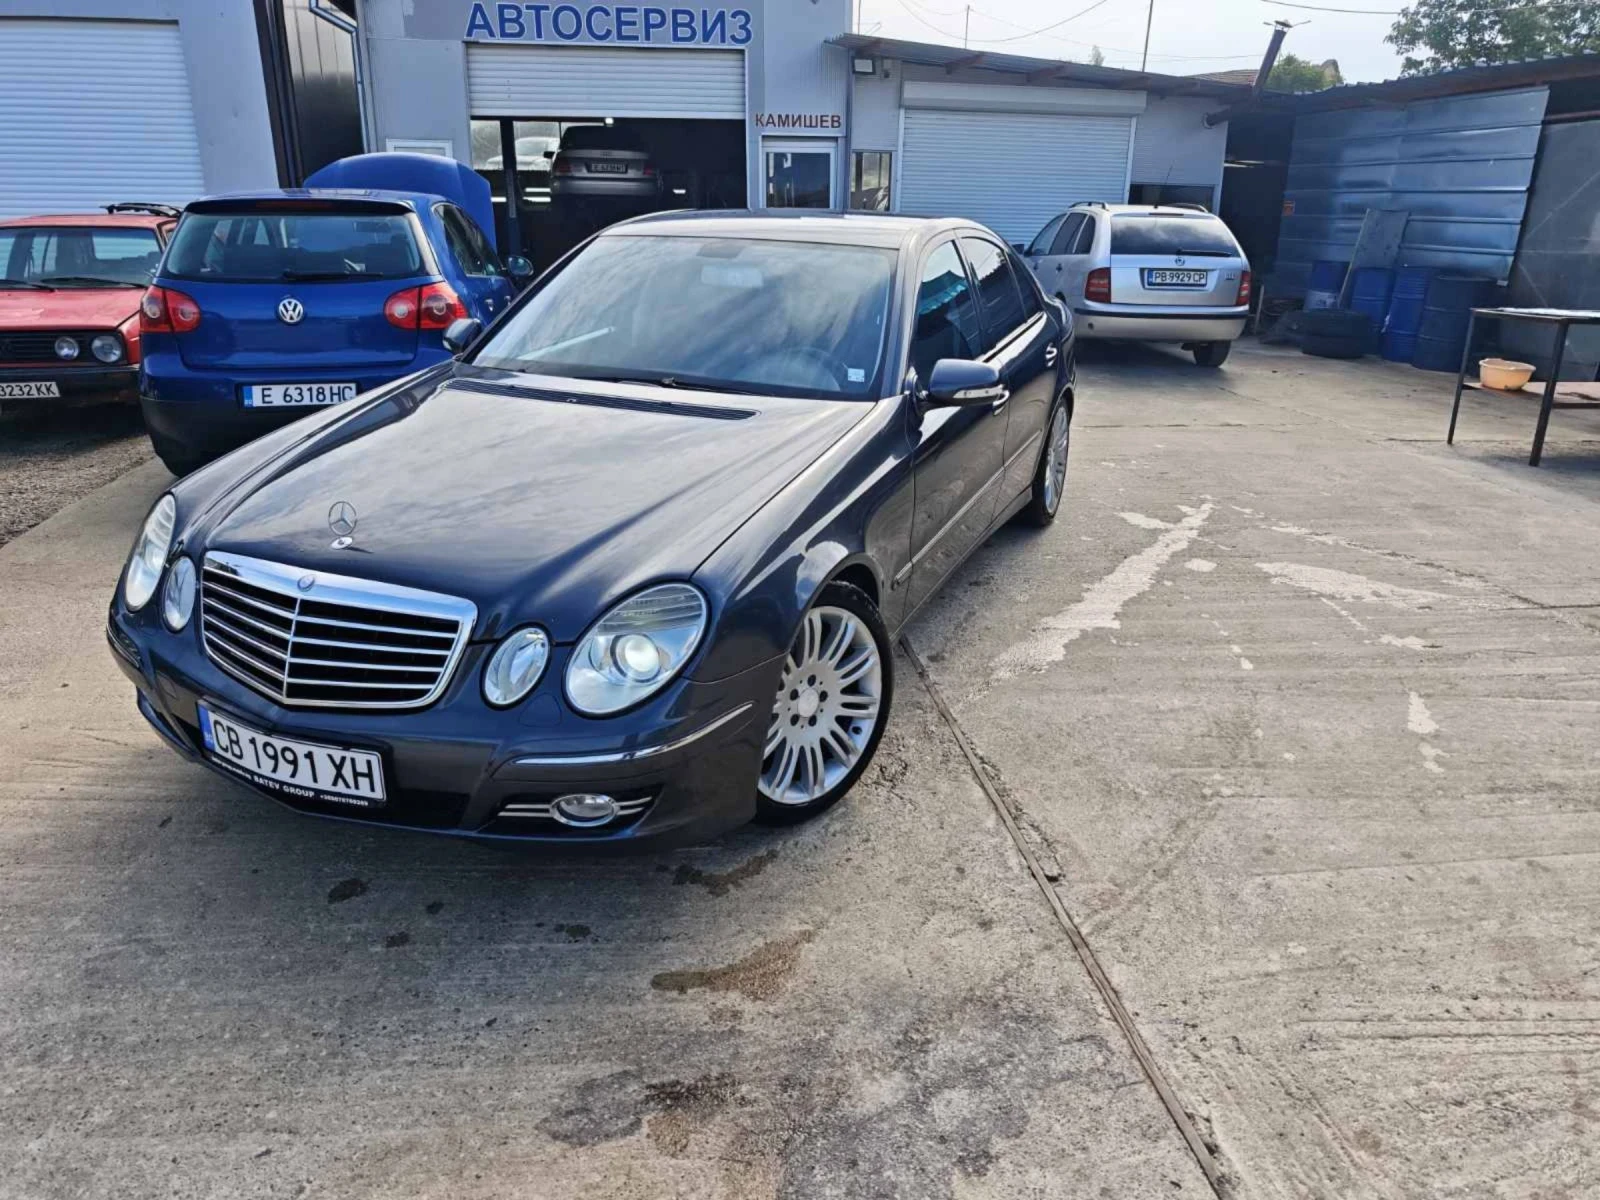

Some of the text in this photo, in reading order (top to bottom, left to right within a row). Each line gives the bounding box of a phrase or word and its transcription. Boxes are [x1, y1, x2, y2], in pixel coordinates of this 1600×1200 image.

[465, 2, 753, 46] АВТОСЕРВИЗ
[755, 112, 842, 129] КАМИШЕВ
[248, 737, 318, 784] 1991
[283, 785, 315, 798] GROUP
